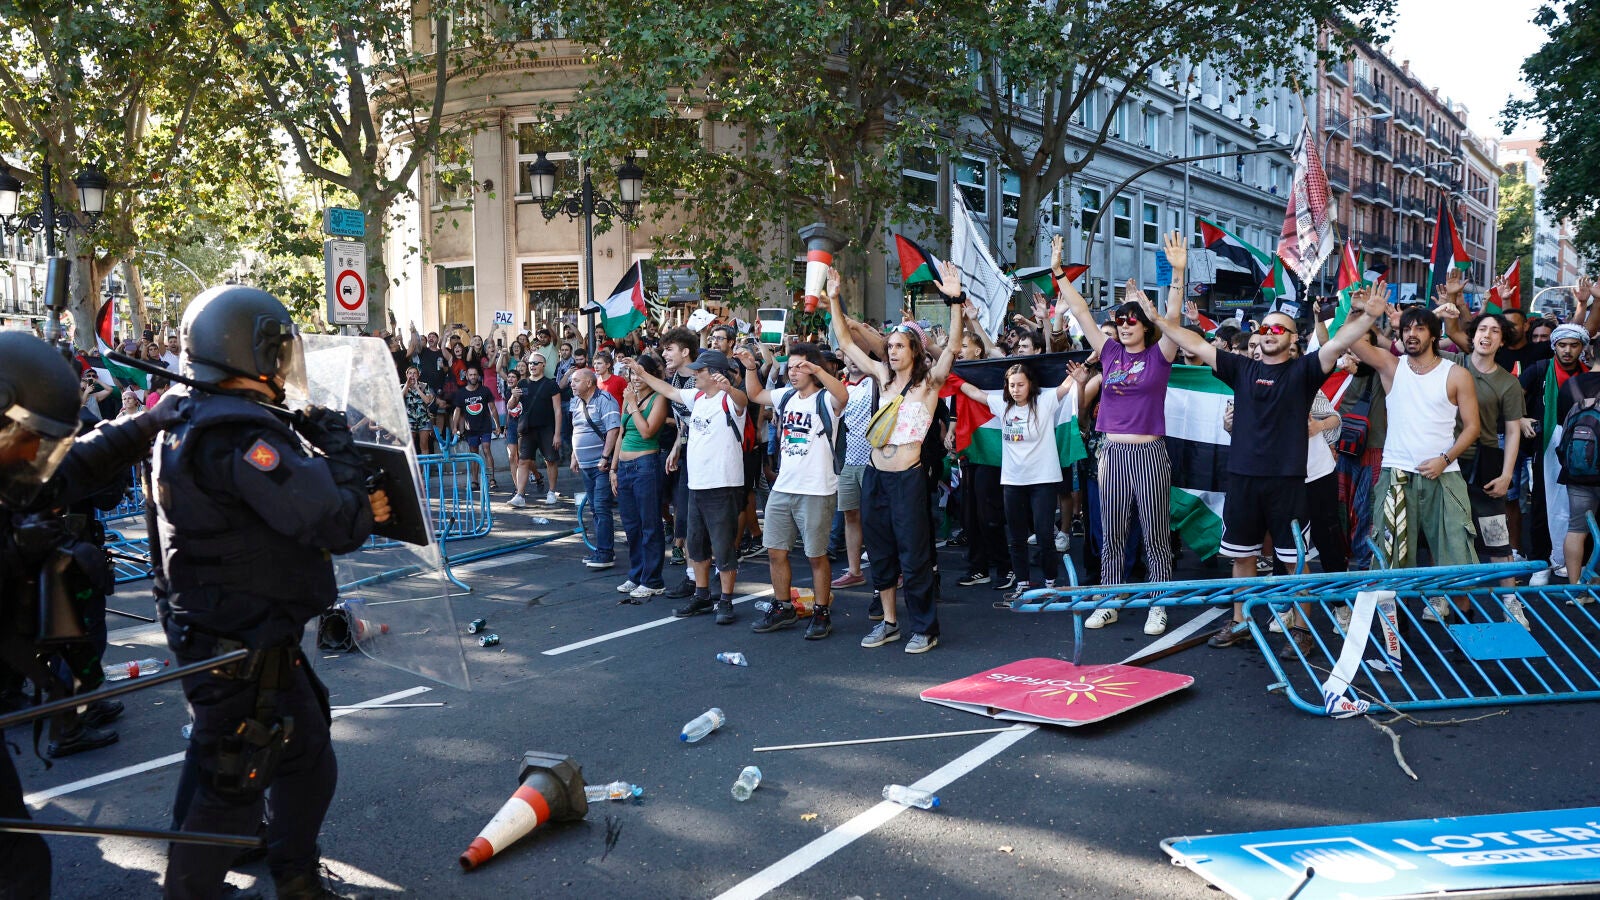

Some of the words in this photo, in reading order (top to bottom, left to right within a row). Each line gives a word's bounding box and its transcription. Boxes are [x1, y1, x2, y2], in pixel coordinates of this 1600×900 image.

[496, 312, 513, 324] PAZ
[783, 410, 812, 429] GAZA
[986, 673, 1095, 692] Cofidis
[1462, 853, 1534, 862] CON
[1539, 849, 1583, 857] EL
